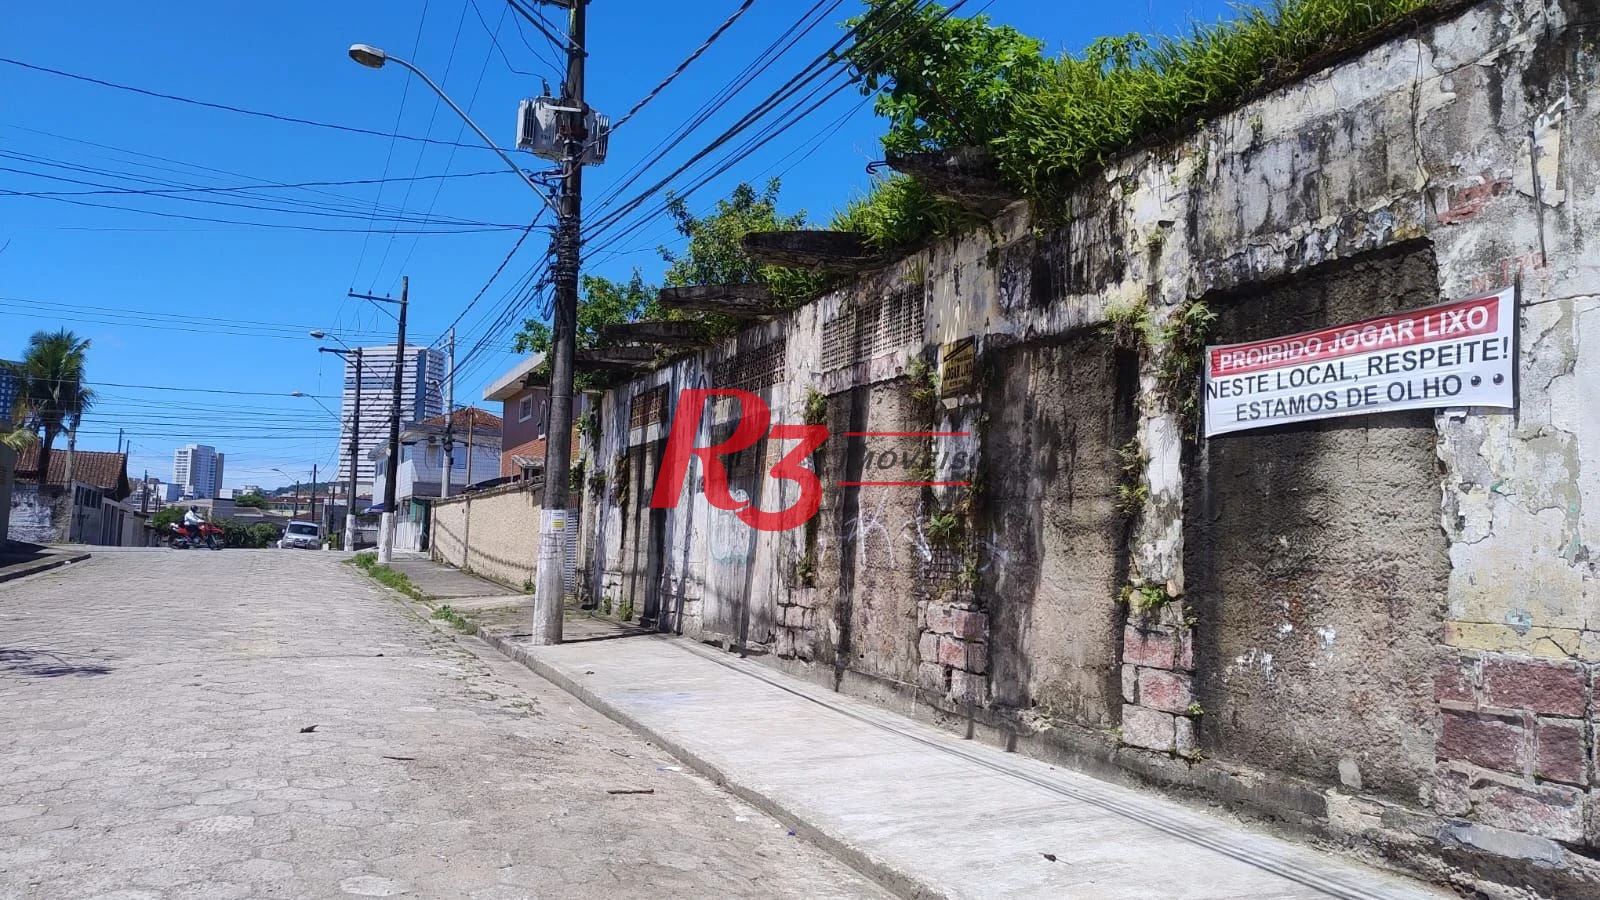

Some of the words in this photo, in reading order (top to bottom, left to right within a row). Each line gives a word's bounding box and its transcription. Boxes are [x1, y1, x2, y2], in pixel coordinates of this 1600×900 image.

[1206, 373, 1269, 401] NESTE
[1277, 361, 1359, 390] LOCAL,
[1367, 336, 1509, 376] RESPEITE!
[1219, 337, 1322, 370] PROIBIDO
[1328, 318, 1416, 353] JOGAR
[1423, 305, 1489, 337] LIXO
[1236, 390, 1338, 422] ESTAMOS
[1347, 384, 1379, 408] DE
[1387, 374, 1462, 402] OLHO
